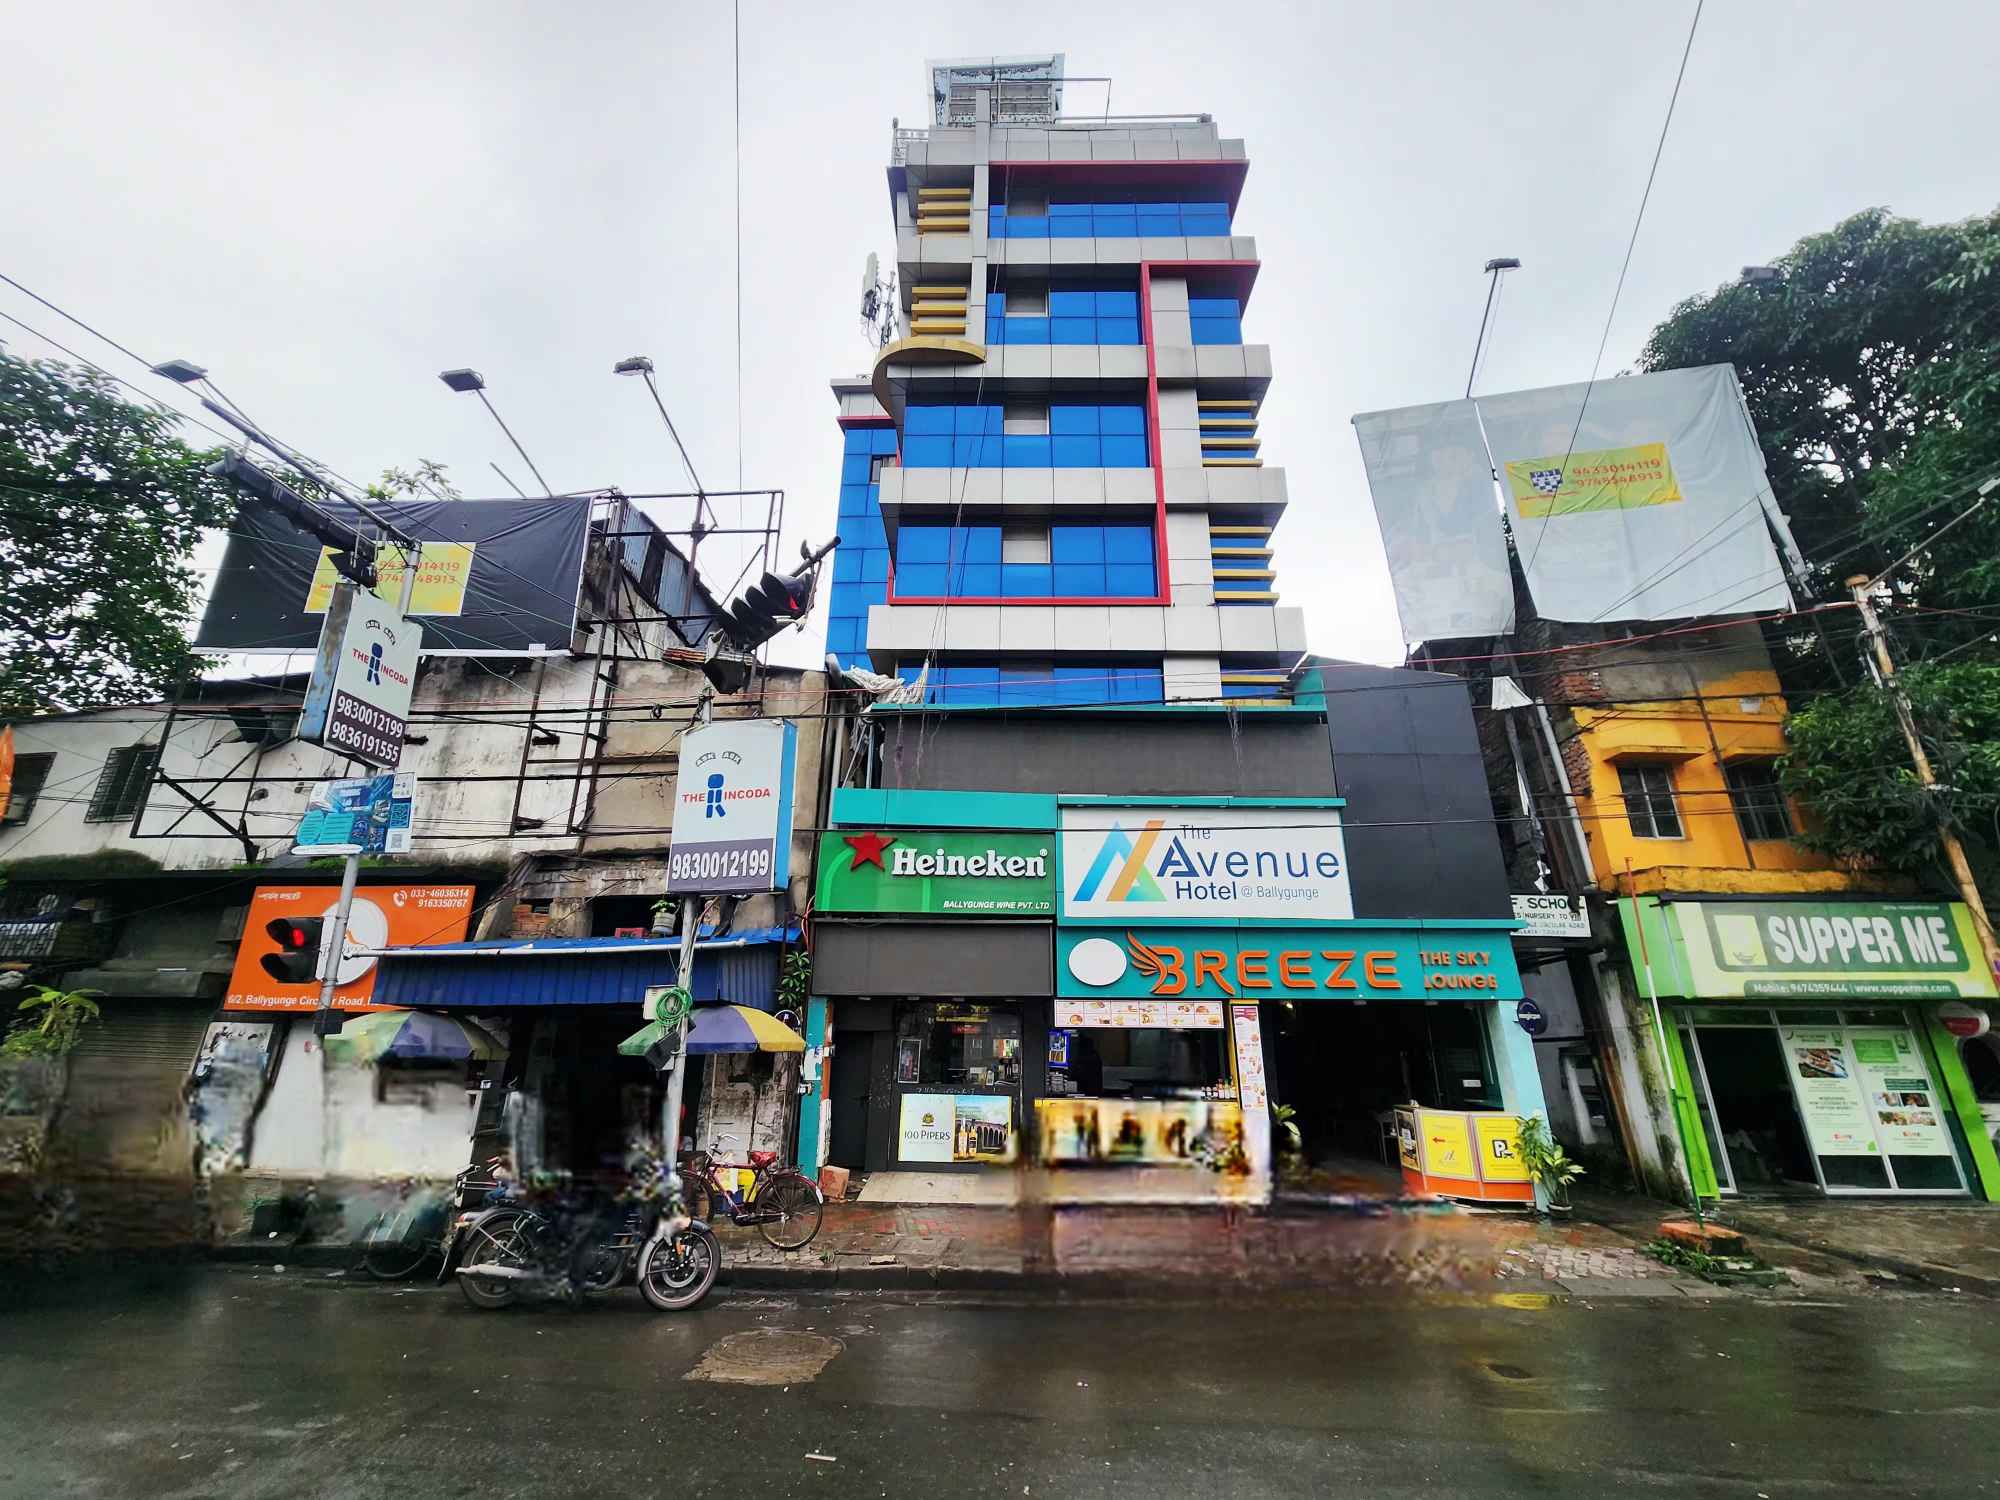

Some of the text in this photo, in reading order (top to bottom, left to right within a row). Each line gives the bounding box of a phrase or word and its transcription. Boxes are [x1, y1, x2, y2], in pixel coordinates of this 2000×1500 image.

[352, 648, 370, 664] THE
[337, 695, 404, 738] 9830012199
[331, 721, 399, 762] 9836191555
[682, 793, 706, 803] THE
[1180, 824, 1211, 840] The
[671, 849, 770, 880] 9830012199
[892, 848, 1048, 878] Heineken
[1156, 835, 1340, 878] Avenue
[1175, 881, 1237, 900] Hotel
[1257, 885, 1319, 900] Ballygunge
[943, 900, 995, 910] BALLYGUNGE
[996, 901, 1016, 910] WINE
[1035, 901, 1050, 910] LTD
[1767, 916, 1958, 965] SUPPER ME
[1420, 951, 1490, 966] THE SKY
[1146, 946, 1403, 996] BREEZE
[1423, 973, 1498, 990] LOUNGE
[246, 994, 297, 1008] Ballygunge
[920, 1129, 951, 1141] PIPERS
